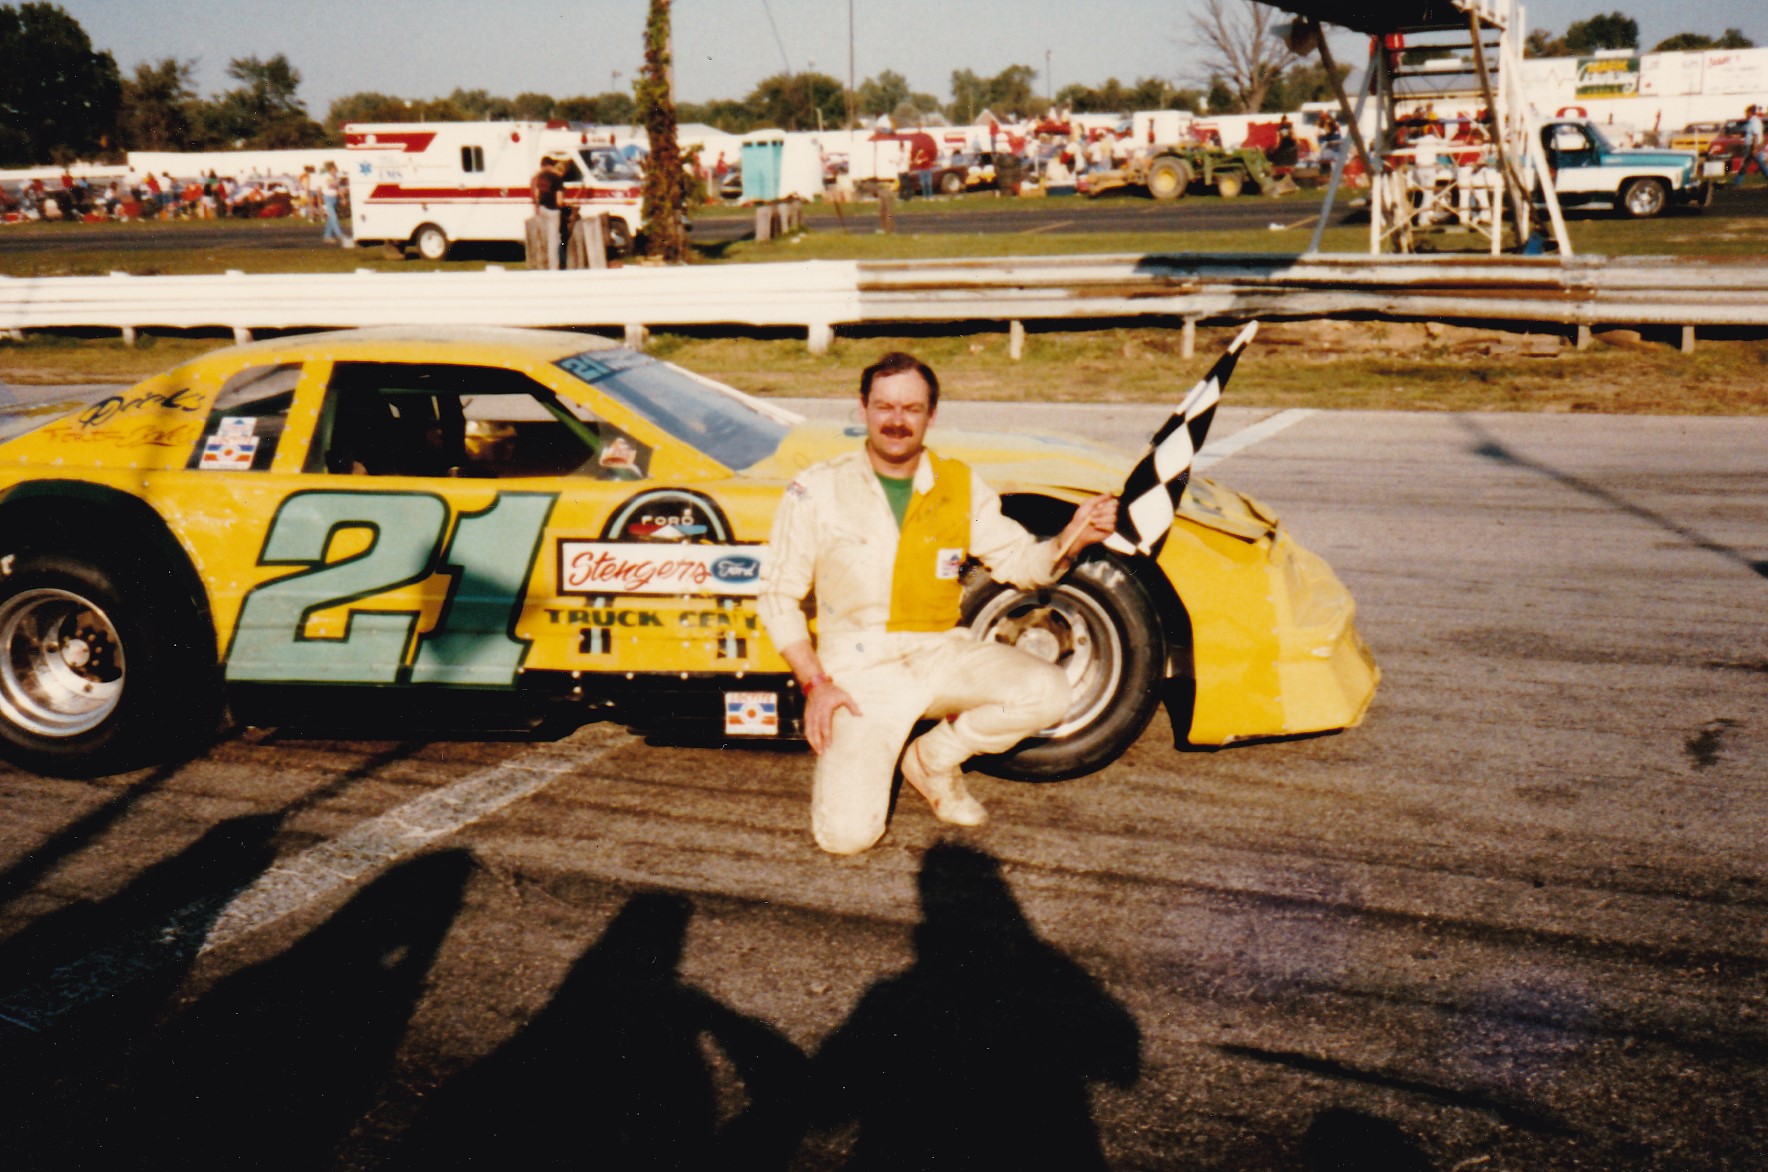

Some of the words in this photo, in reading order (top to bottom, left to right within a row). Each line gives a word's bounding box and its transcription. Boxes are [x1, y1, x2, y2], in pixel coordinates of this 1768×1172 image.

[641, 515, 694, 526] FORD
[568, 551, 712, 591] Stengers
[714, 558, 758, 580] Ford
[223, 488, 561, 688] 21
[543, 608, 664, 627] TRUCK
